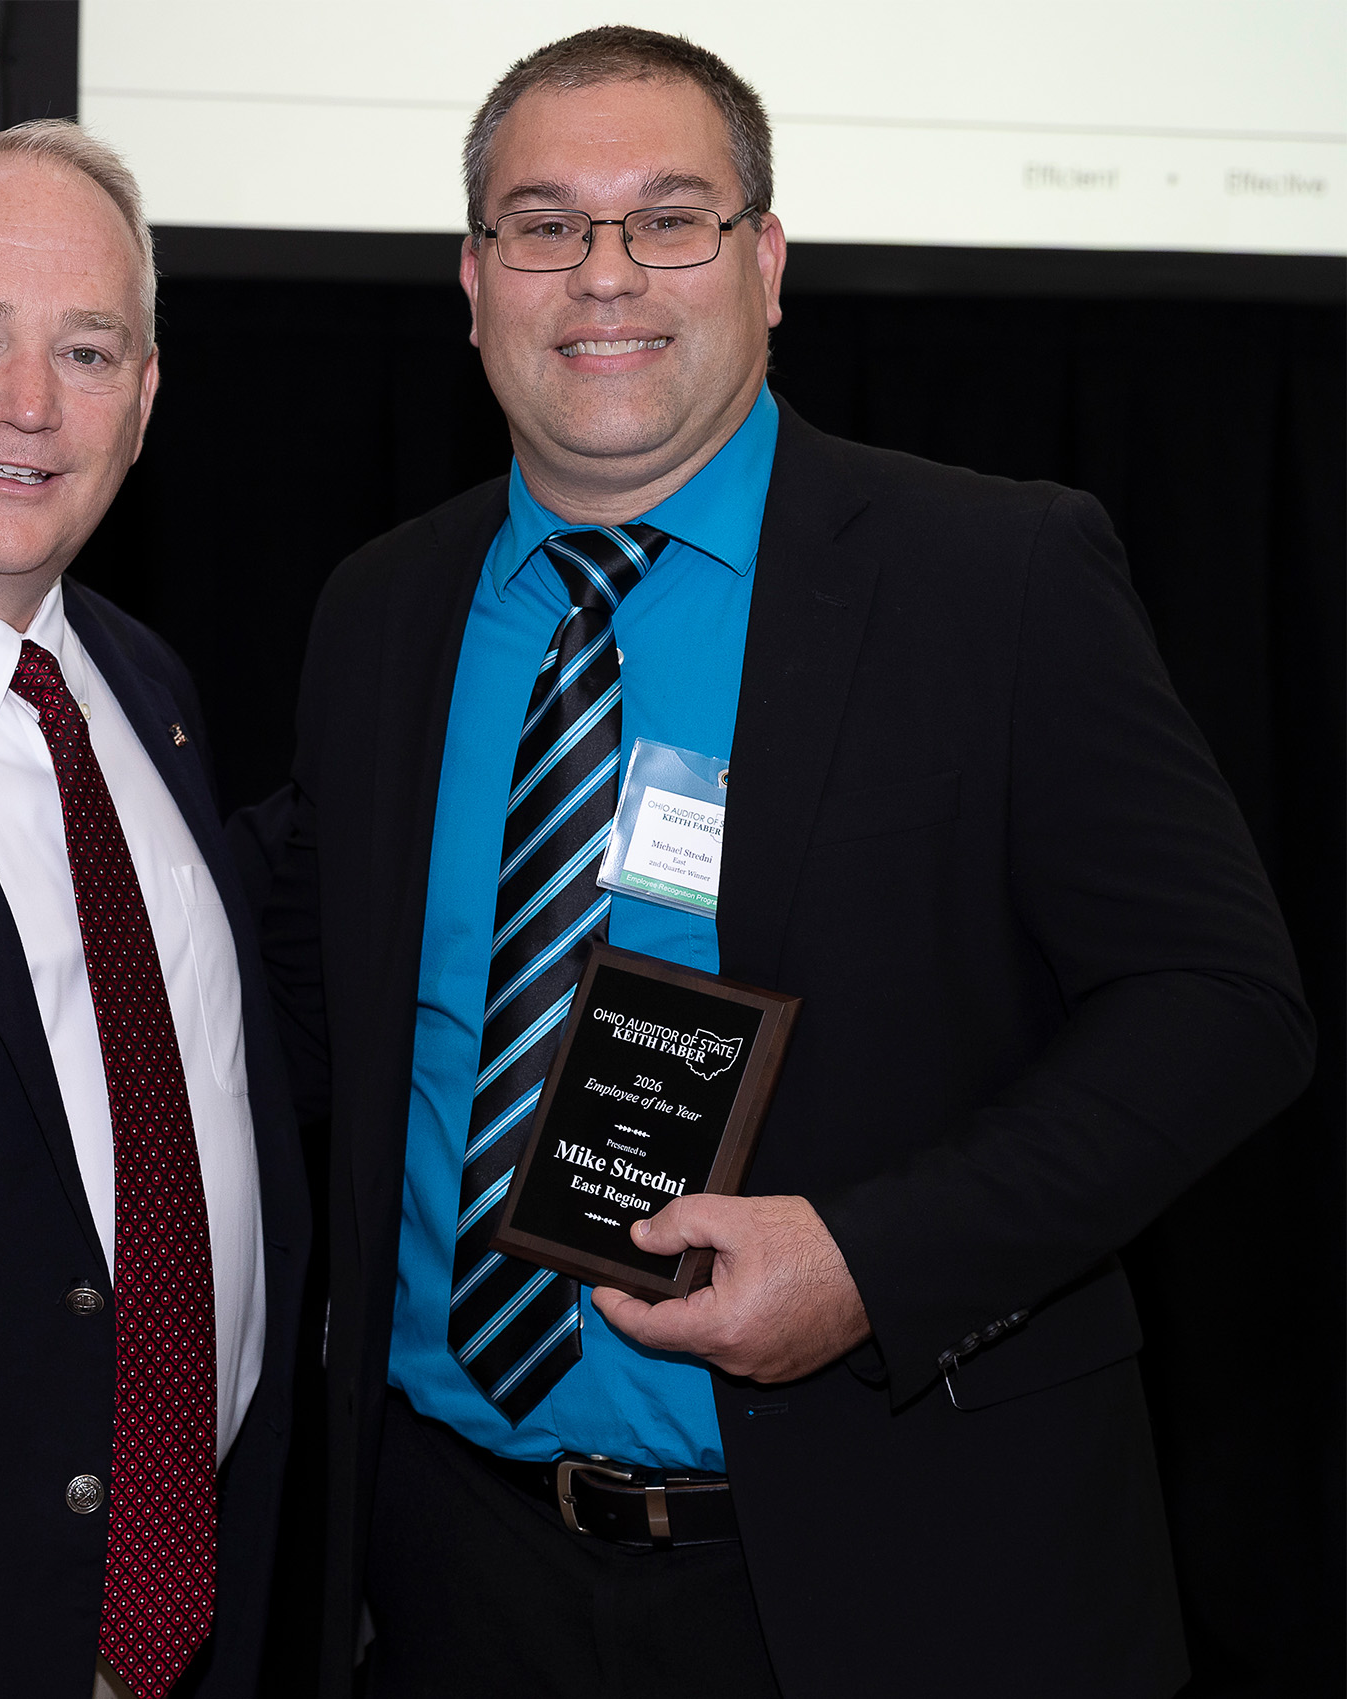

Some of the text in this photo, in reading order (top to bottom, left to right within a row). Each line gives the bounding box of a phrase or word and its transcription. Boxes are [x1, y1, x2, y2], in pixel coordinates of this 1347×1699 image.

[1024, 163, 1326, 194] Efficient Effective
[648, 800, 670, 813] OHIO
[671, 807, 705, 822] AUDITOR
[707, 817, 719, 826] OF
[662, 813, 691, 828] KEITH
[692, 821, 721, 836] FABER
[651, 840, 713, 864] Michael Stredni
[672, 857, 686, 866] East
[648, 860, 711, 882] 2nd Quarter Winner
[626, 874, 717, 906] Employee Recognition Progra
[593, 1008, 735, 1059] OHIO AUDITOR OF STATE
[612, 1026, 706, 1064] KEITH FABER
[633, 1075, 663, 1092] 2026
[584, 1077, 702, 1122] Employee of the Year
[606, 1138, 647, 1157] Presented to
[553, 1139, 686, 1197] Mike Stredni
[570, 1175, 652, 1212] East Region
